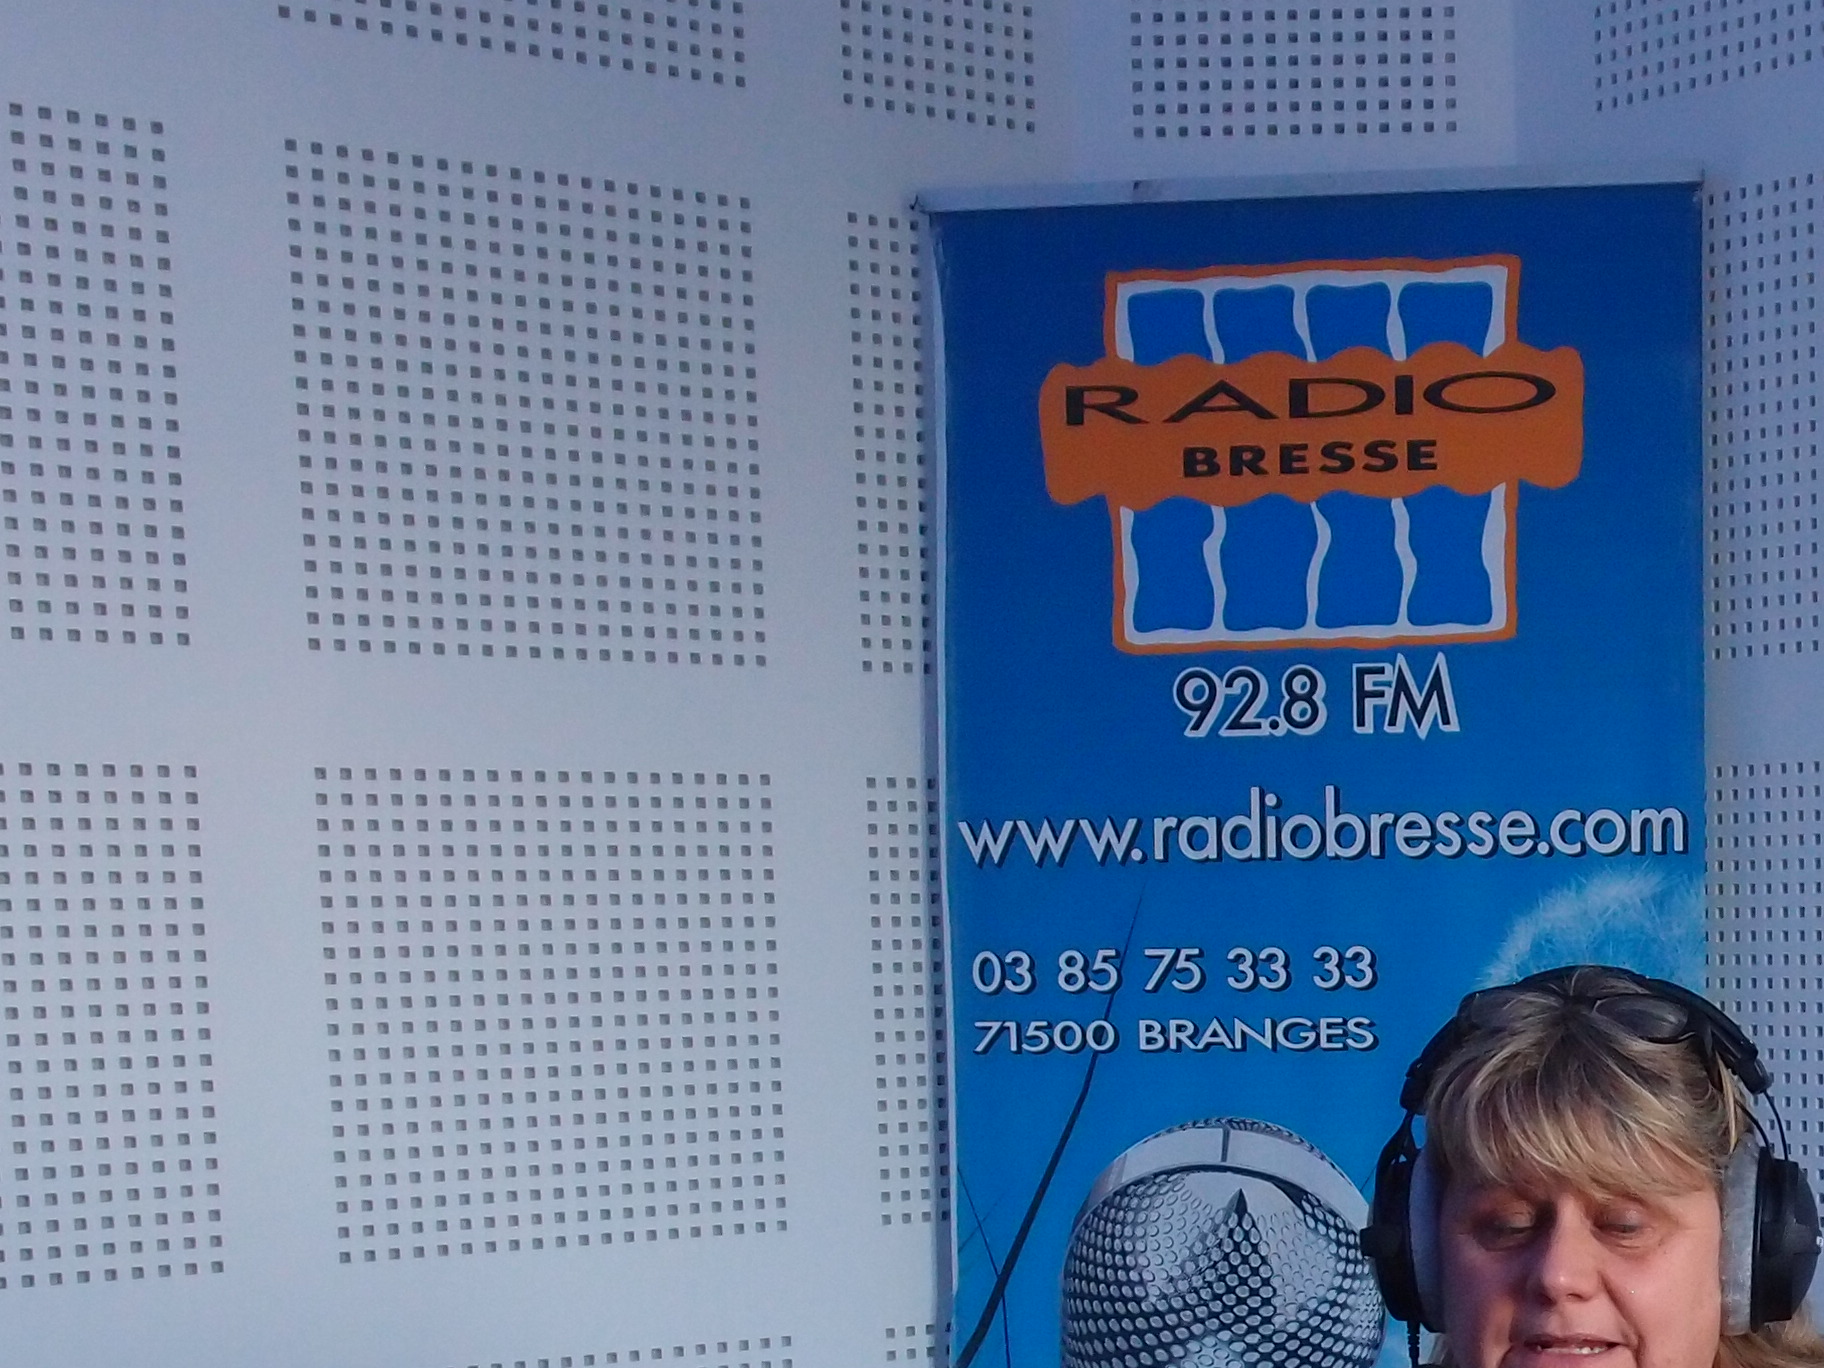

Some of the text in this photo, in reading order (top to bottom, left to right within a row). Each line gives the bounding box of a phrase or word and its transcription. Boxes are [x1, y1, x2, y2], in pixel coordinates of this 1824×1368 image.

[1064, 370, 1557, 426] RADIO
[1182, 438, 1439, 479] BRESSE
[1173, 653, 1460, 740] 92.8 FM
[958, 785, 1689, 867] www.radiobresse.com
[972, 945, 1378, 995] 03 85 75 33 33
[973, 1017, 1379, 1055] 71500 BRANGES
